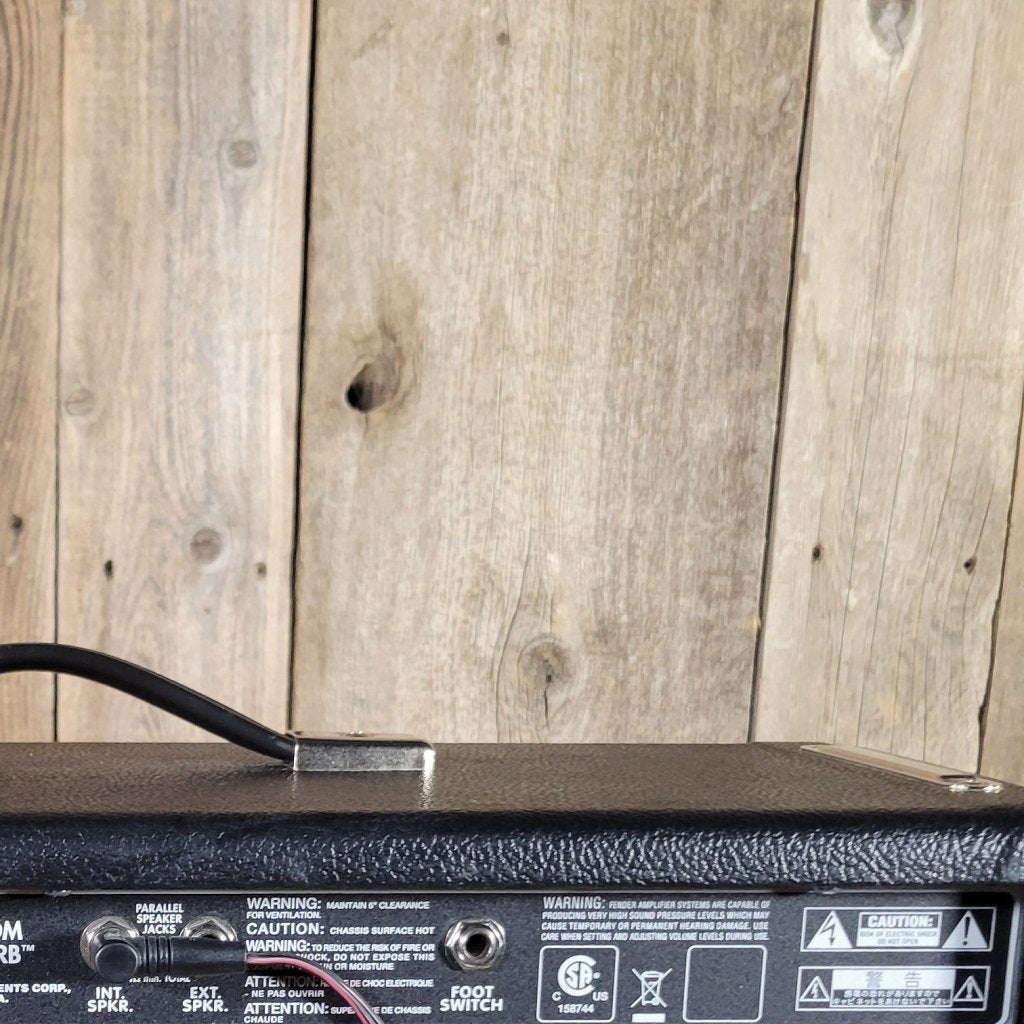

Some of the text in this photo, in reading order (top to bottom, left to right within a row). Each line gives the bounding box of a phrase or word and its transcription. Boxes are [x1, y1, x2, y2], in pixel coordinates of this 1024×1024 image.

[135, 903, 184, 914] PARALLEL
[247, 898, 430, 910] WARNING: MAINTAIN 6" CLEARANCE
[543, 897, 606, 910] WARNING:
[136, 914, 183, 924] SPEAKER
[246, 911, 321, 919] FOR VENTILATION.
[867, 915, 934, 928] CAUTION:
[142, 924, 177, 935] JACKS
[246, 923, 435, 935] CAUTION: CHASSIS SURFACE HOT
[246, 940, 435, 952] WARNING: TO REDUCE THE RISK OF FIRE OR
[334, 953, 435, 962] DO NOT EXPOSE THIS
[334, 963, 394, 971] OR MOISTURE
[245, 976, 319, 988] ATTENTION:
[350, 979, 361, 988] DE
[362, 979, 385, 988] CHOC
[386, 979, 435, 988] ELECTRIQUE
[32, 984, 72, 995] CORP.,
[95, 986, 125, 1000] INT.
[189, 986, 222, 999] EXT.
[251, 990, 325, 998] NE PAS OUVRIR
[450, 985, 494, 999] FOOT
[593, 992, 608, 1001] US
[87, 999, 134, 1013] SPKR.
[182, 999, 229, 1013] SPKR.
[244, 1002, 432, 1015] ATTENTION: DE CHASSIS
[440, 998, 504, 1012] SWITCH
[557, 1003, 594, 1013] 158744
[244, 1016, 284, 1024] CHAUDE
